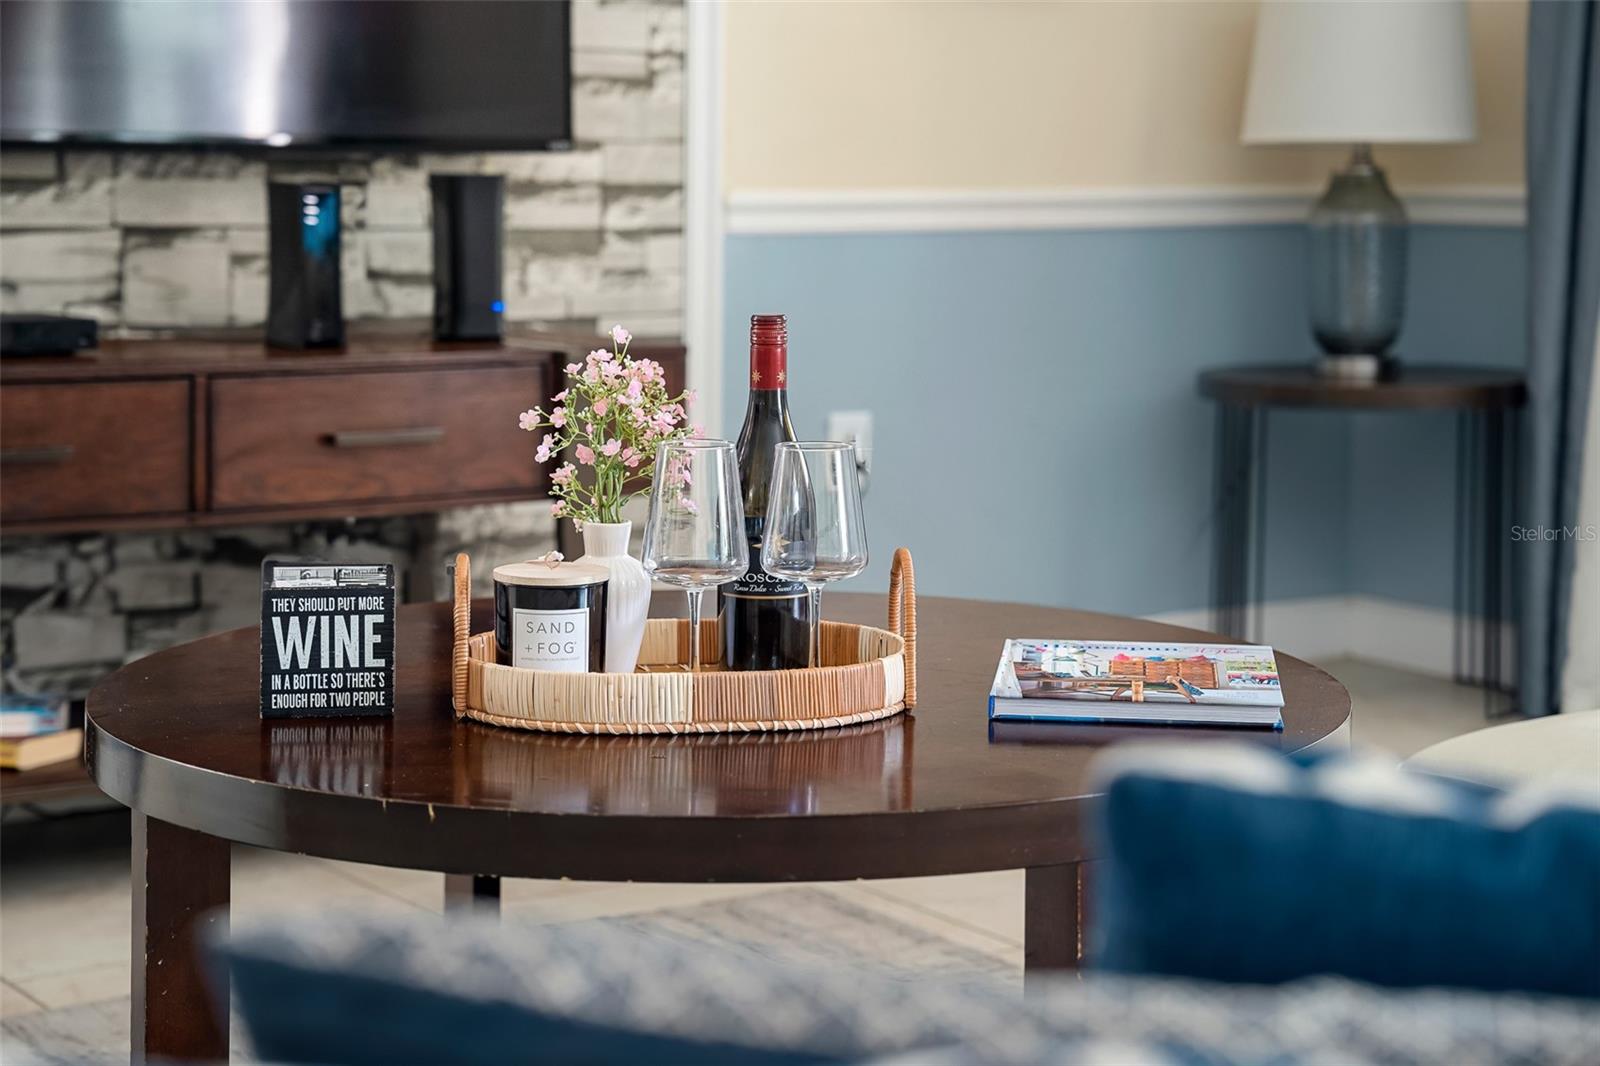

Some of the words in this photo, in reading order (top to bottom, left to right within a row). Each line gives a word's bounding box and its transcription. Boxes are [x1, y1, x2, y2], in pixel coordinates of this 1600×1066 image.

[272, 598, 296, 612] THEY
[298, 597, 335, 612] SHOULD
[338, 597, 356, 612] PUT
[358, 596, 385, 611] MORE
[526, 621, 575, 634] SAND
[271, 614, 386, 670] WINE
[537, 641, 575, 655] FOG
[271, 674, 281, 690] IN
[284, 674, 291, 690] A
[293, 673, 328, 690] BOTTLE
[330, 673, 344, 689] SO
[346, 672, 385, 688] THERE'S
[271, 693, 308, 709] ENOUGH
[310, 693, 327, 708] FOR
[329, 692, 350, 707] TWO
[353, 691, 386, 707] PEOPLE
